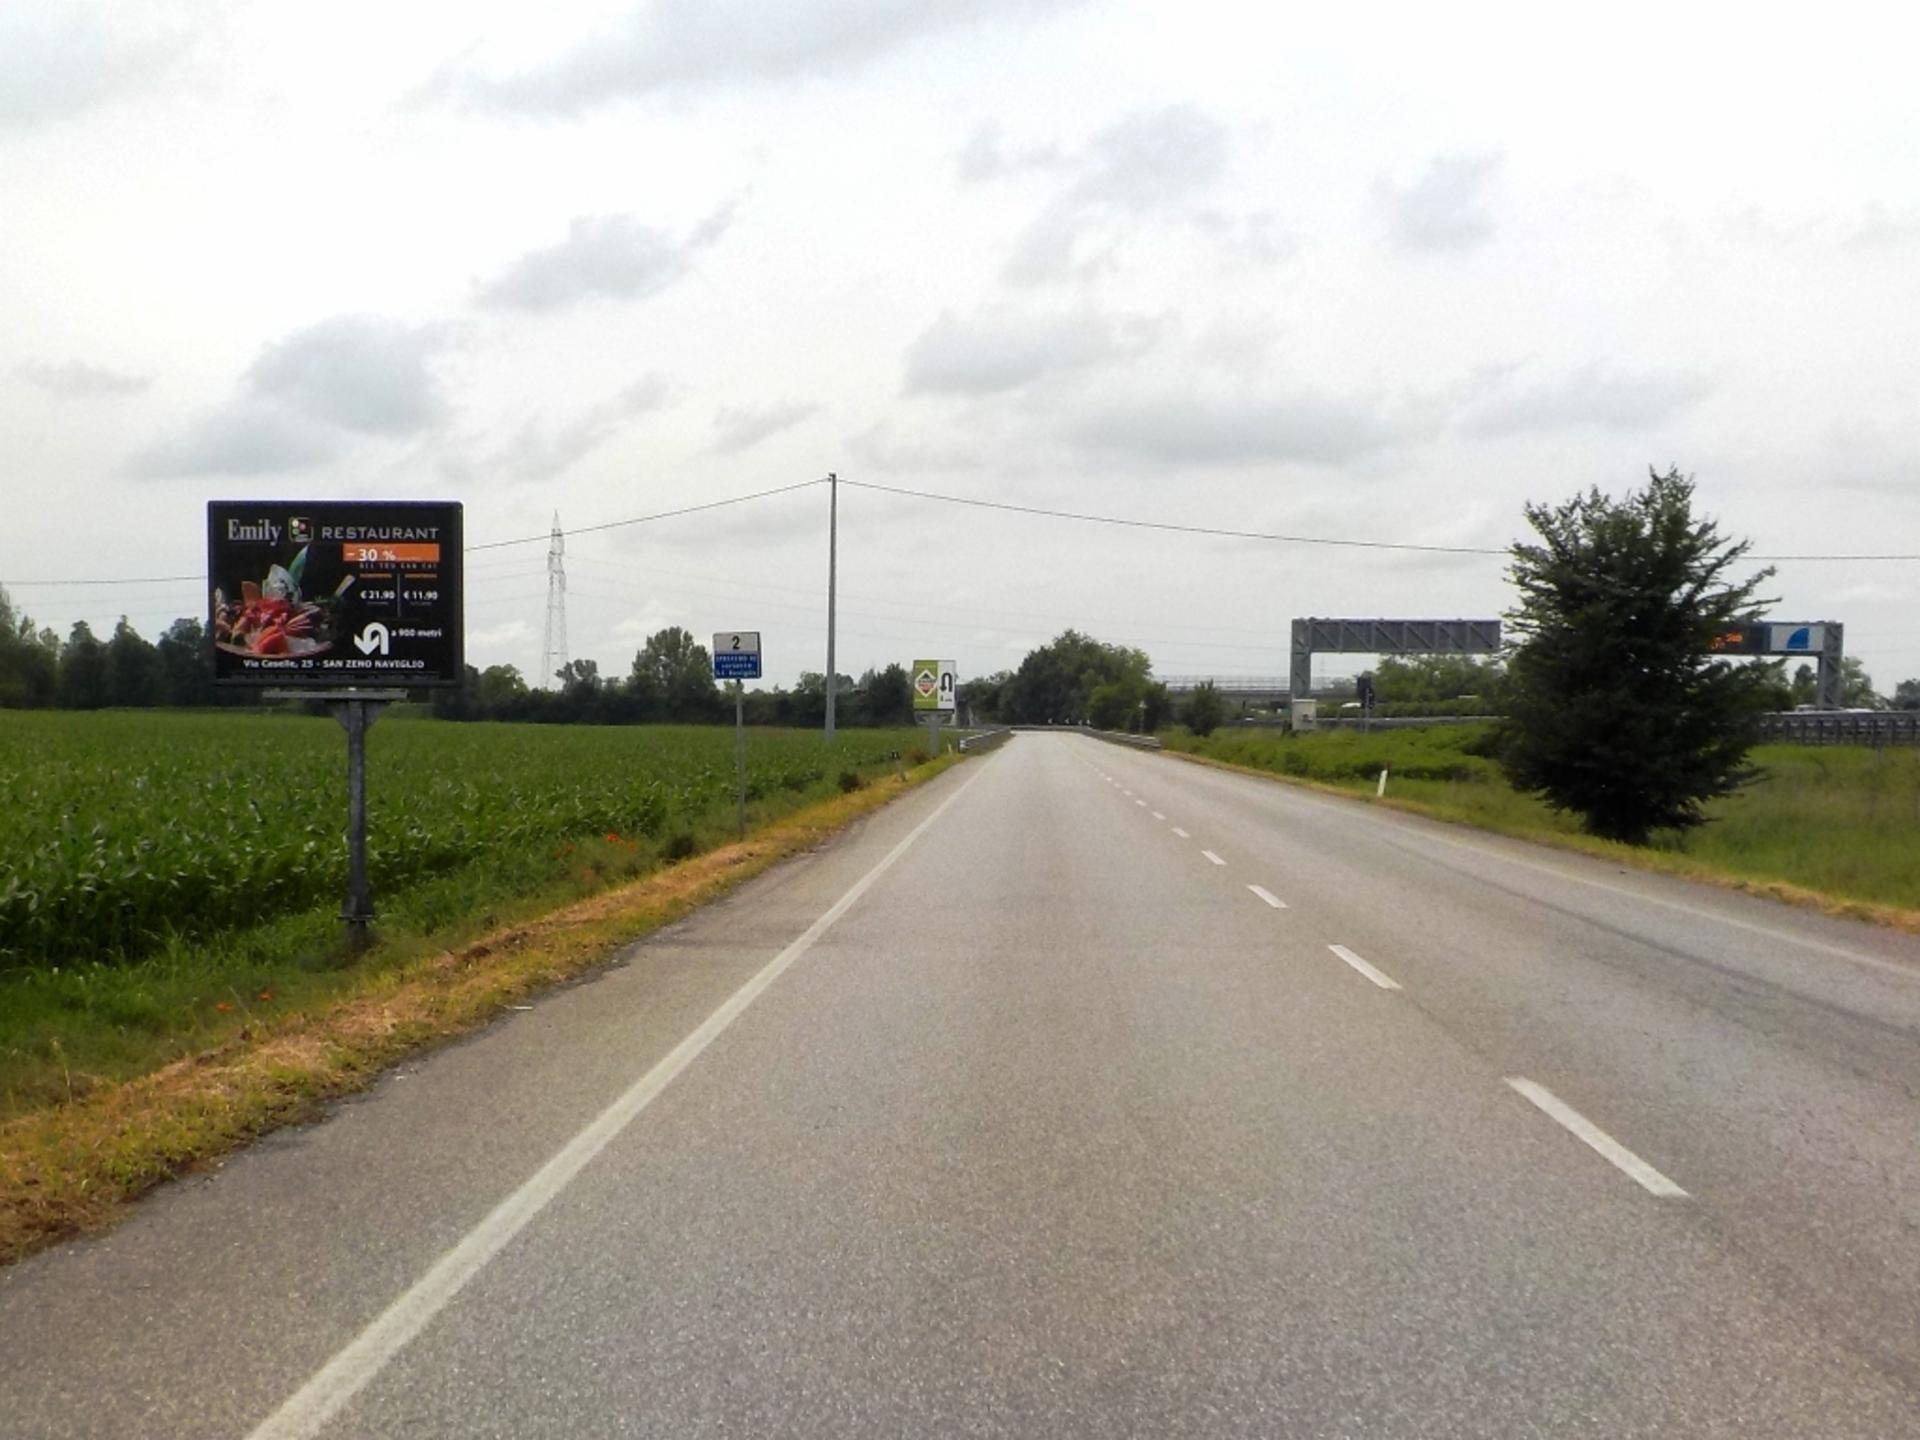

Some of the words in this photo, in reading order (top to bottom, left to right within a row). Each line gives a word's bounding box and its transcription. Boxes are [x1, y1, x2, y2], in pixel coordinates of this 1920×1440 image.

[227, 519, 282, 546] Emily
[321, 526, 440, 539] RESTAURANT
[358, 548, 378, 561] 30
[732, 635, 741, 650] 2
[242, 659, 259, 668] Via
[323, 659, 343, 668] SAN
[346, 659, 371, 668] ZENO
[375, 659, 425, 669] NAVIGLIO
